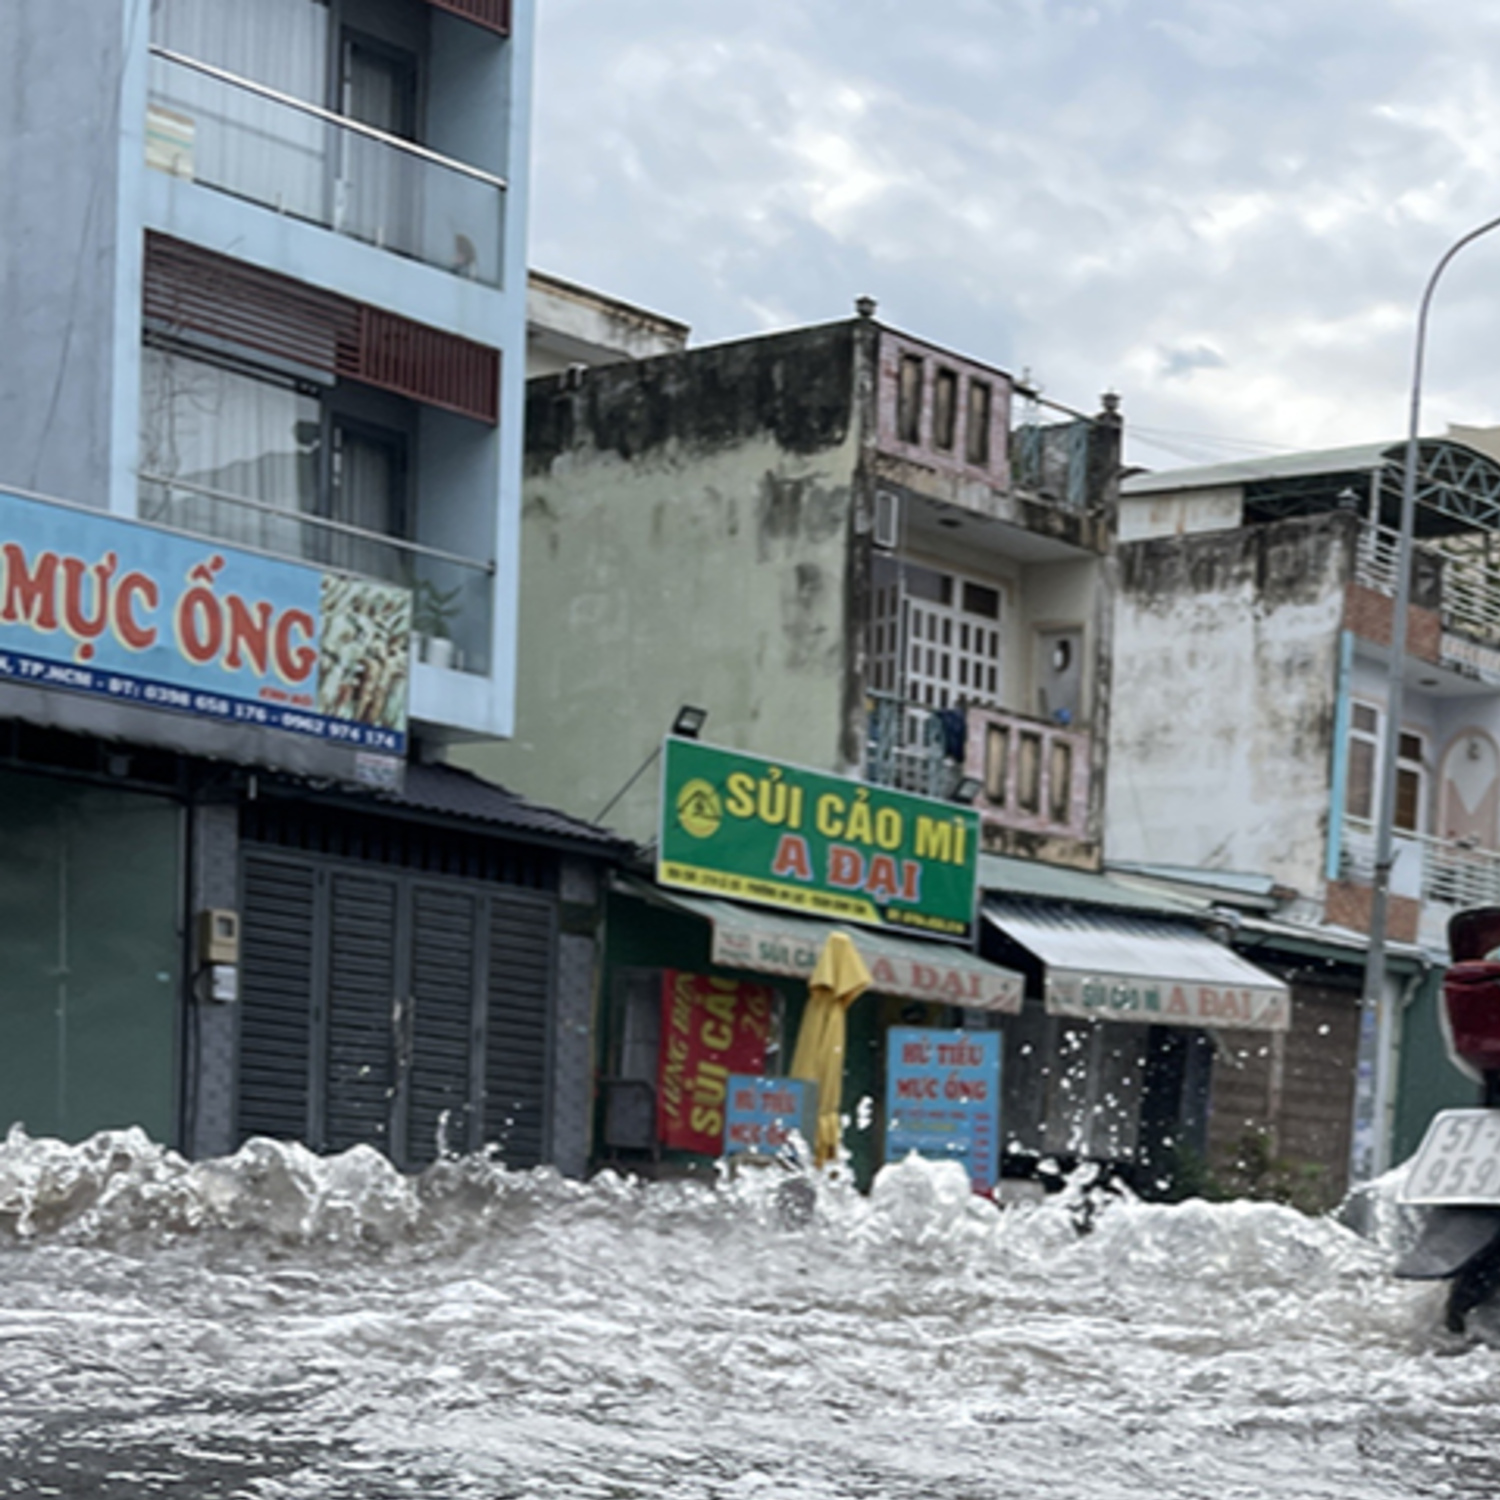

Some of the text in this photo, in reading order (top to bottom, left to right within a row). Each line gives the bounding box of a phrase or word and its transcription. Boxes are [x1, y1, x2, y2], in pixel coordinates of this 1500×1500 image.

[2, 543, 317, 683] MỰC ỐNG
[725, 767, 966, 866] SỦI CẢO MÌ
[771, 833, 813, 882] A
[827, 844, 921, 905] ĐẠI
